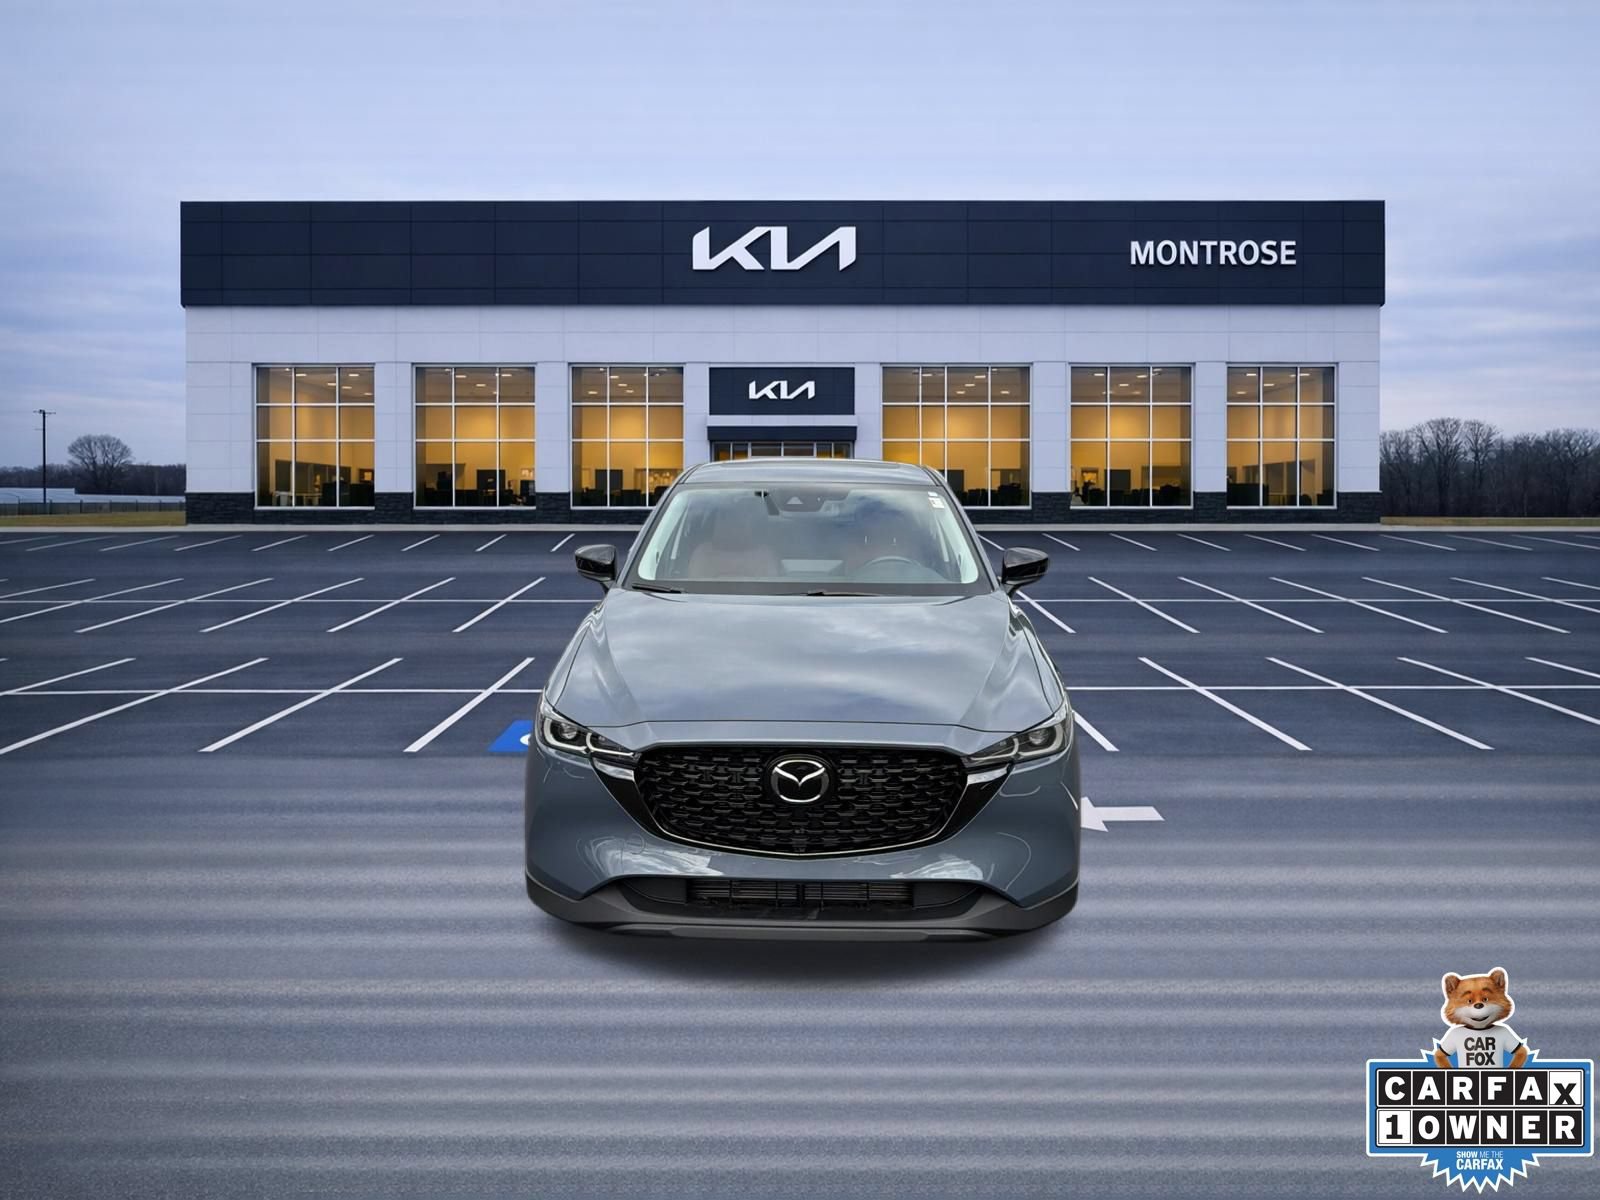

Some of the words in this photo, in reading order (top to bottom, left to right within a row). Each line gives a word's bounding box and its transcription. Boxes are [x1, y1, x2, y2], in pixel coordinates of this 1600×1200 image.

[692, 226, 857, 271] KIA
[1130, 240, 1297, 265] MONTROSE
[748, 380, 816, 400] KIA
